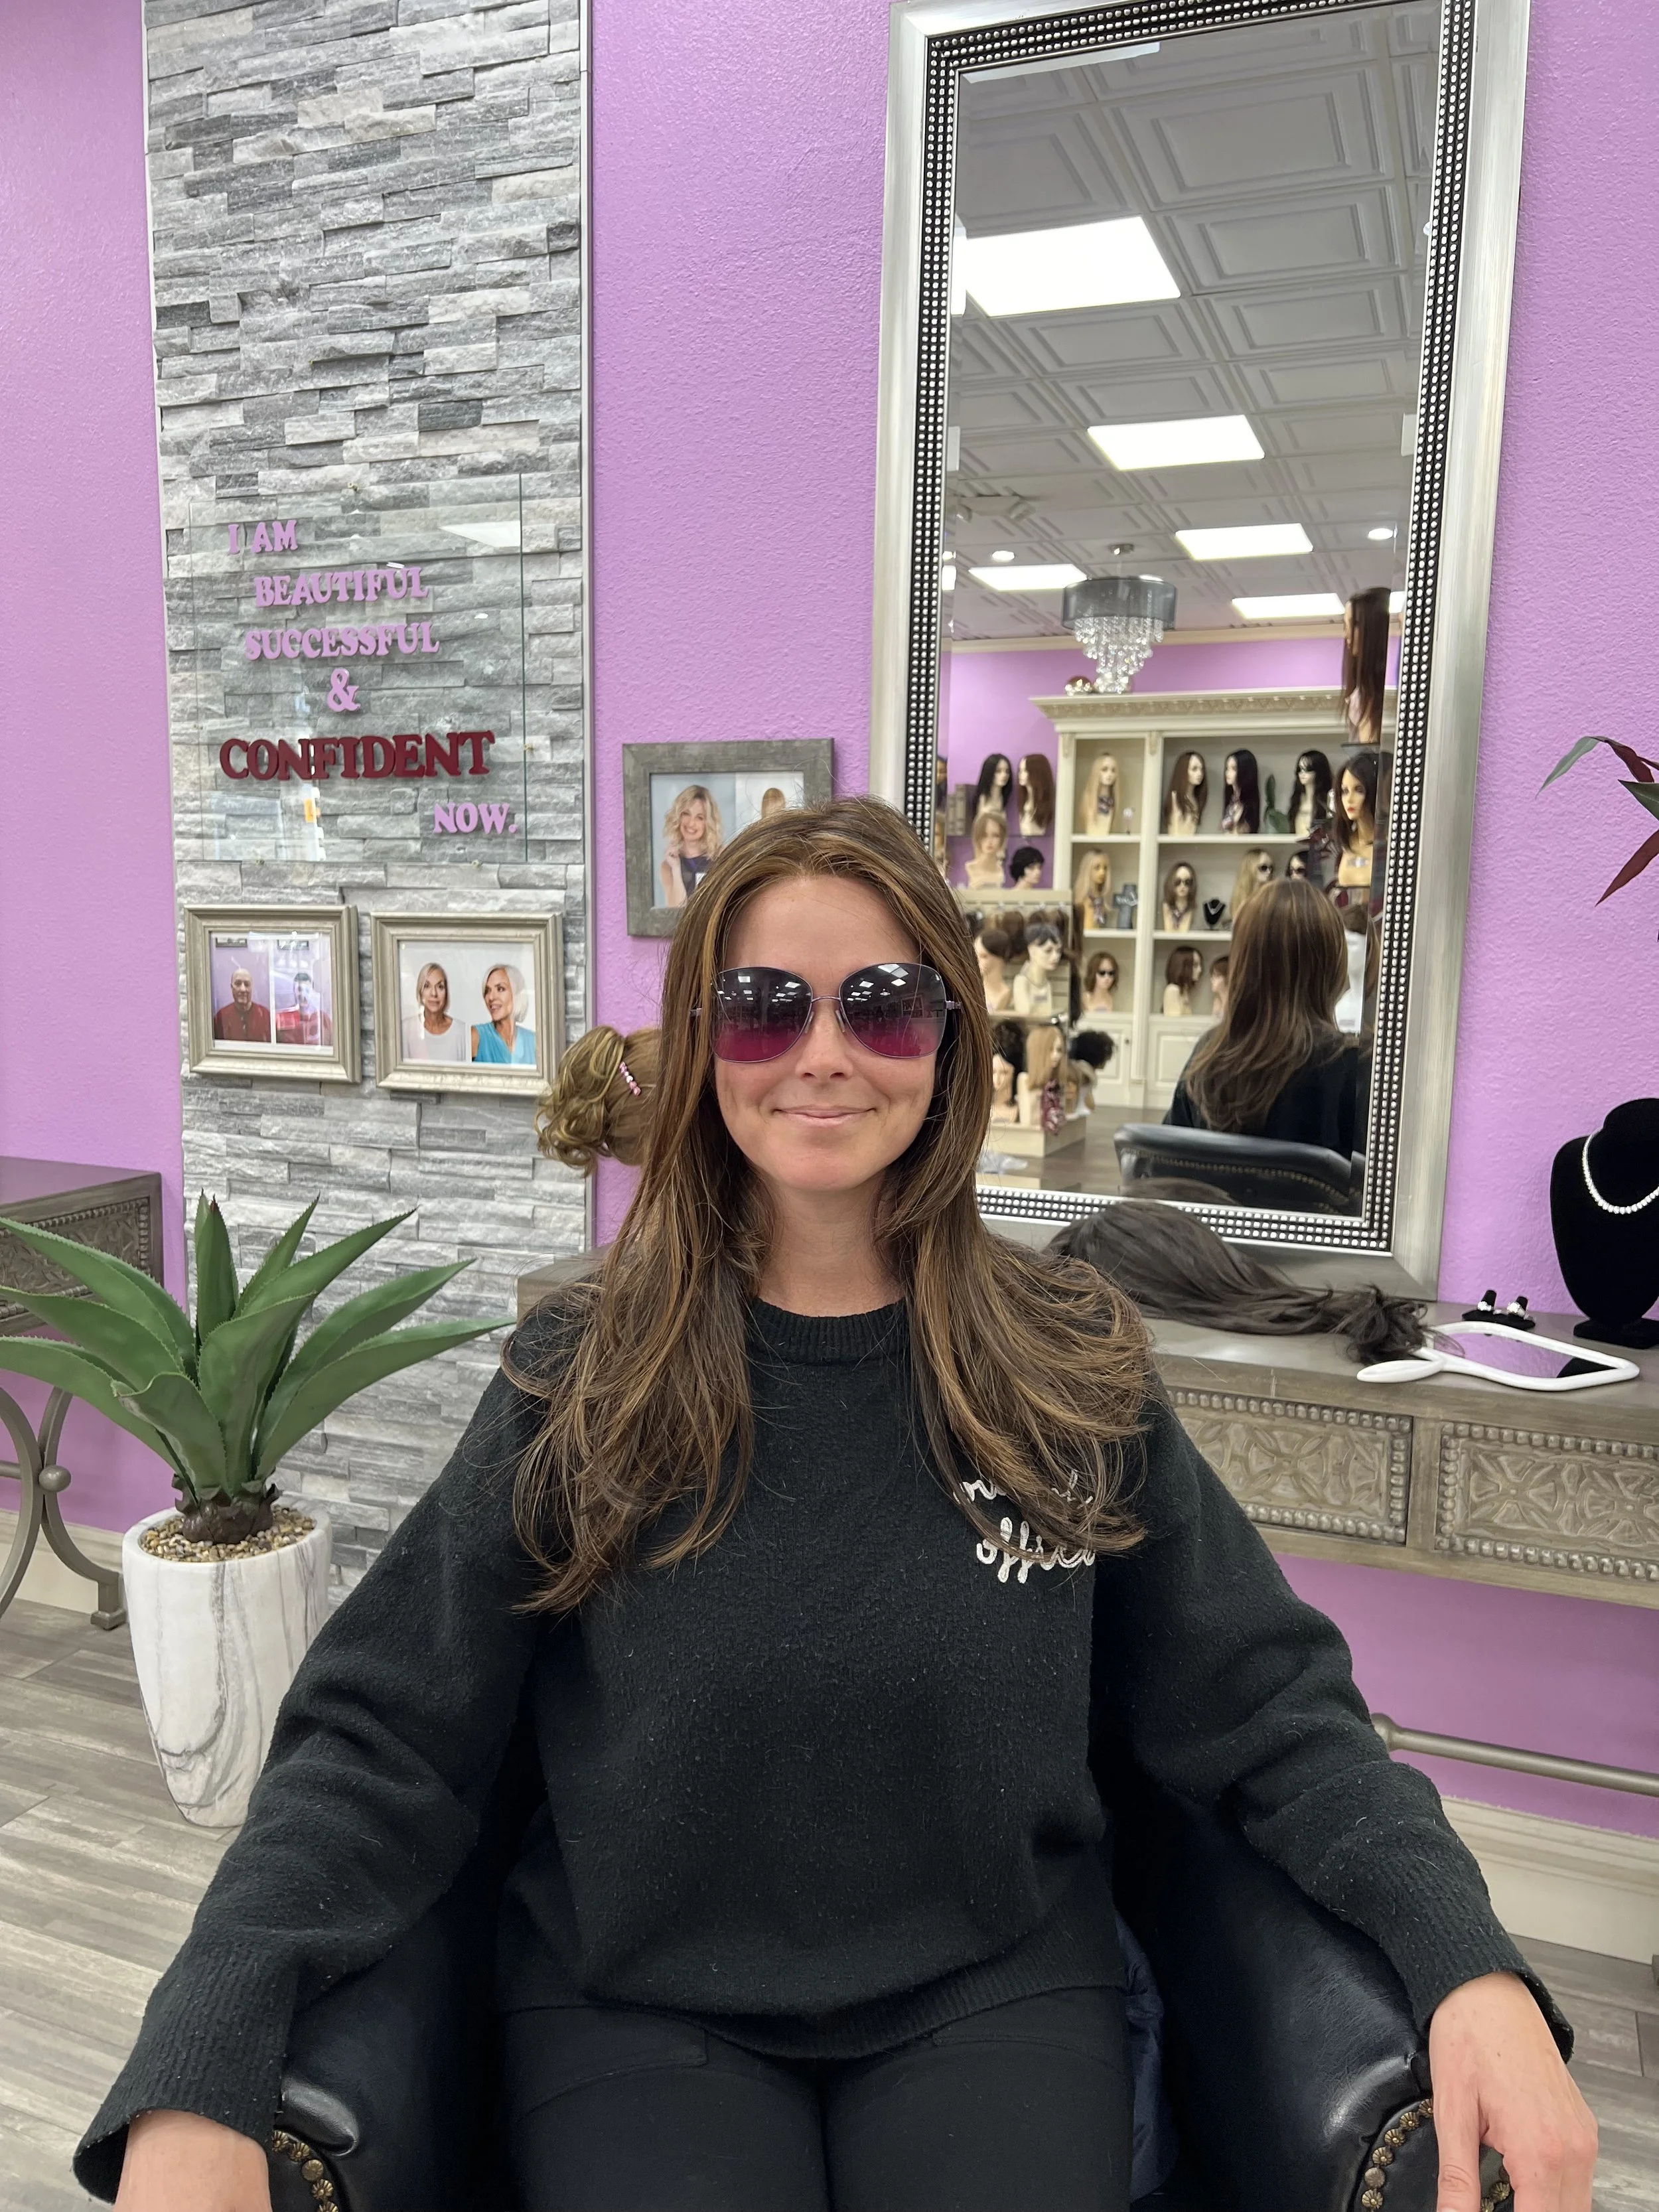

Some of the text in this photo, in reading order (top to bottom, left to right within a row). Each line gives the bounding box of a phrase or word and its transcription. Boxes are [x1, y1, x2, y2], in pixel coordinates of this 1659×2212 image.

[228, 520, 298, 554] I AM
[253, 567, 429, 607] BEAUTIFUL
[245, 622, 439, 660] SUCCESSFUL
[326, 668, 360, 712] &
[220, 730, 495, 780] CONFIDENT
[433, 802, 518, 834] NOW.
